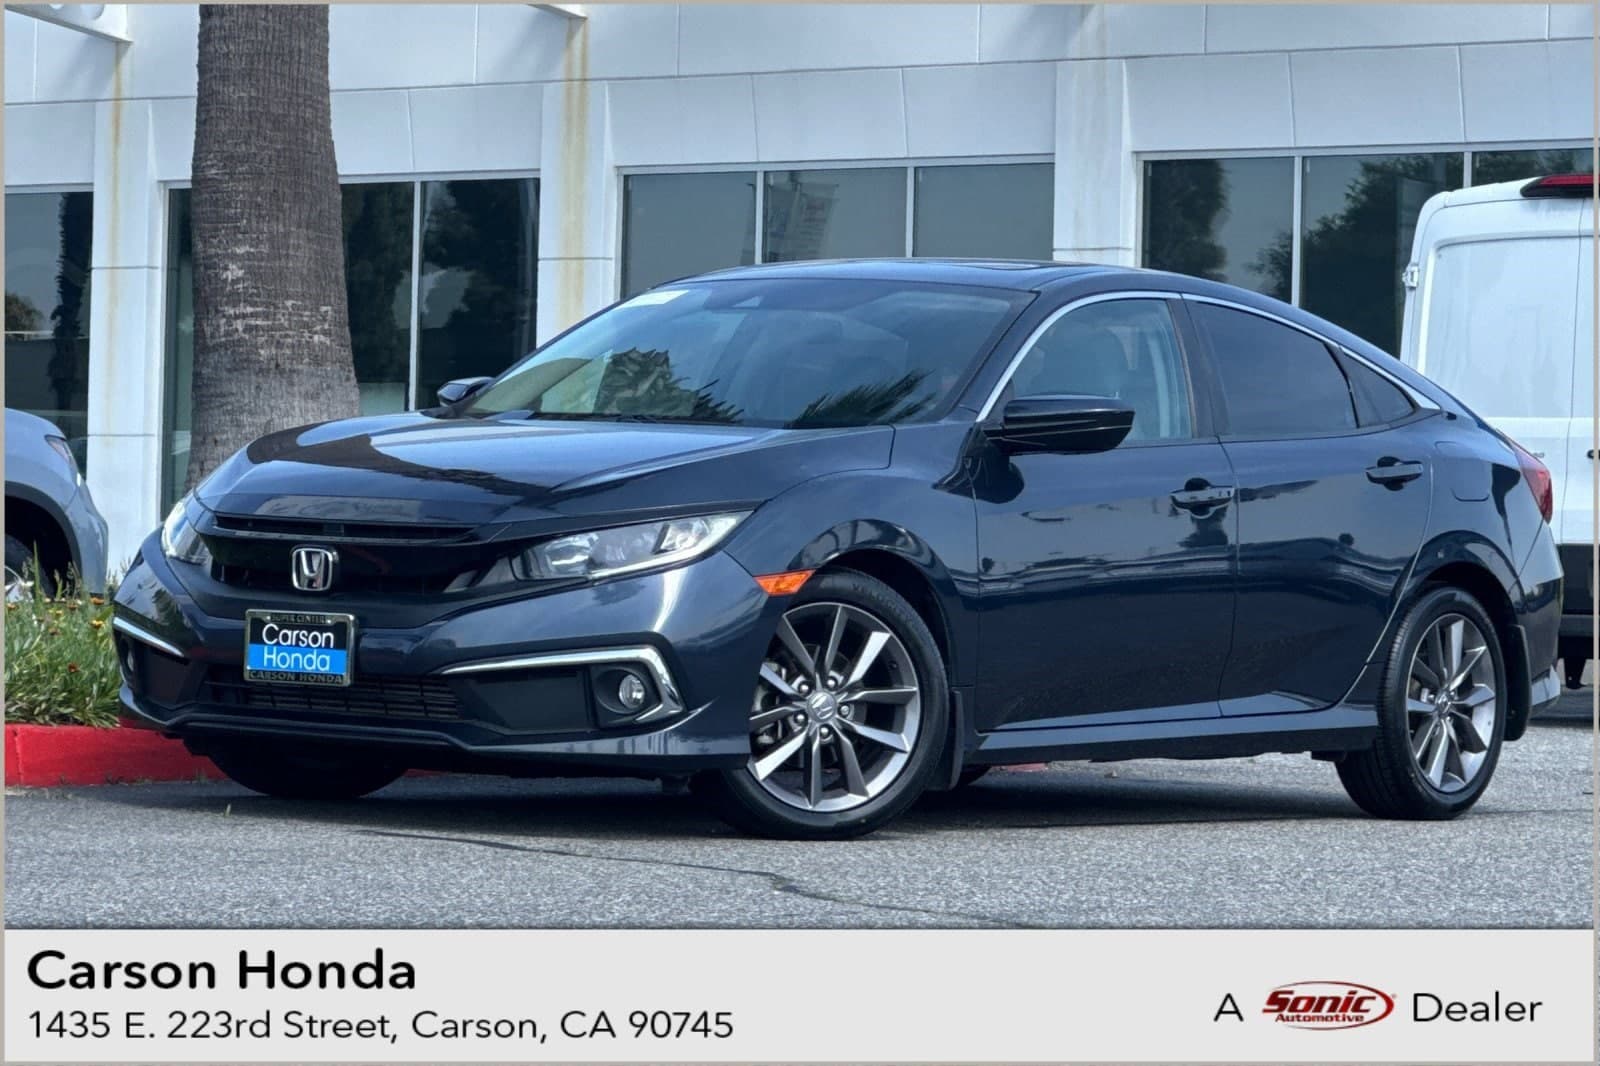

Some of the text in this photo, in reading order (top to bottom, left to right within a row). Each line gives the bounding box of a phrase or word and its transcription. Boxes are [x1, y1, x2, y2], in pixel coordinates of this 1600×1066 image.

[262, 623, 334, 649] Carson
[263, 646, 331, 671] Honda
[250, 671, 342, 684] CARSON HONDA
